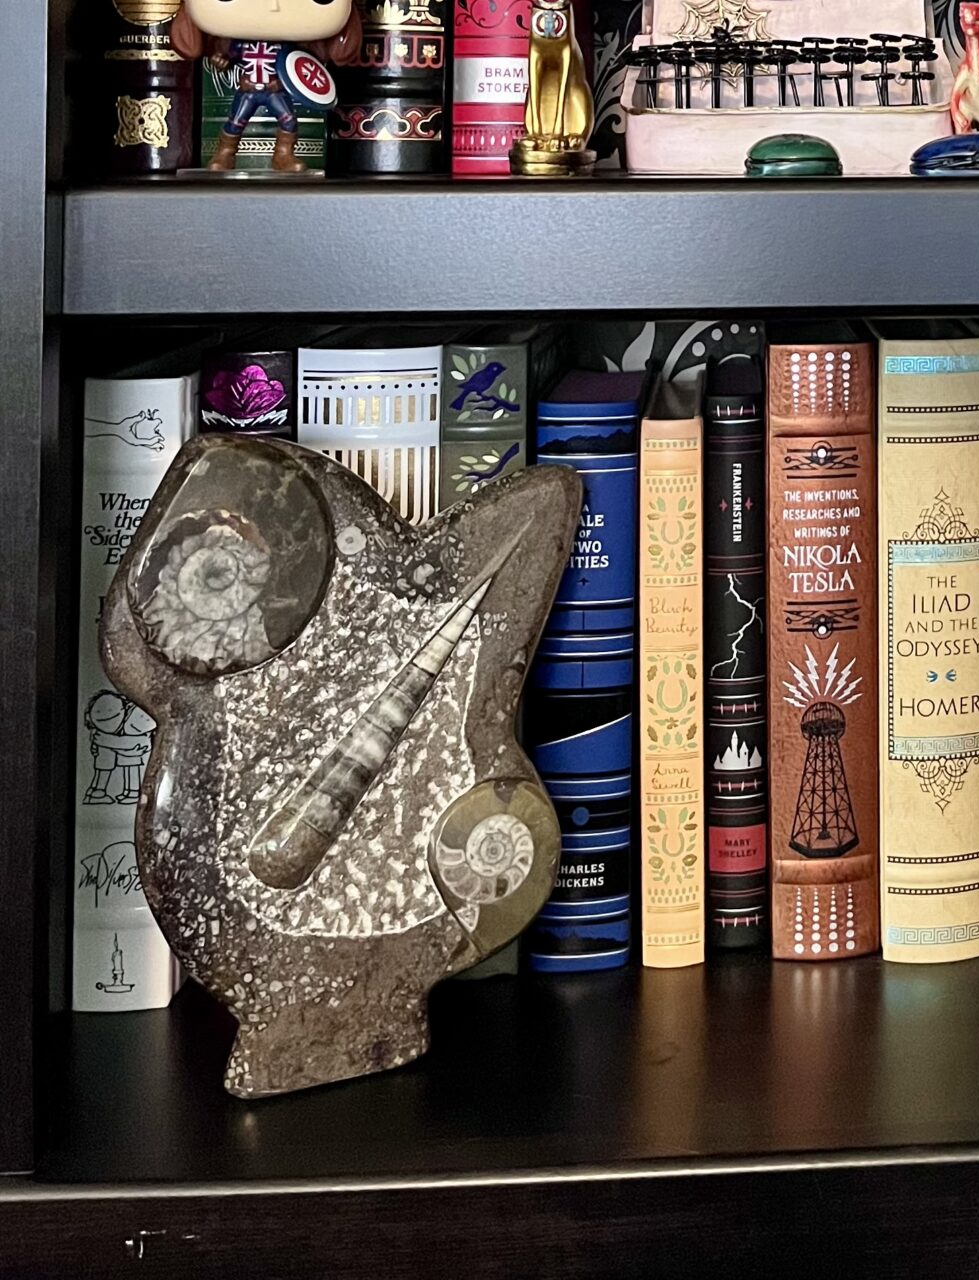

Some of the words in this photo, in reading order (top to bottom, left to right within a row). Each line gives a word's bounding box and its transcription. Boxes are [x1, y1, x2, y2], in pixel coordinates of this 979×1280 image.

[120, 34, 170, 45] GUERBER
[484, 66, 525, 79] BRAM
[733, 463, 742, 542] FRANKENSTEIN
[784, 490, 801, 502] THE
[783, 508, 841, 520] RESEARCHES
[843, 507, 860, 517] AND
[579, 530, 591, 538] OF
[794, 527, 837, 538] WRITINGS
[839, 525, 850, 536] OF
[783, 542, 861, 570] NIKOLA
[788, 569, 854, 592] TESLA
[927, 575, 957, 589] THE
[912, 593, 971, 614] ILIAD
[905, 619, 944, 633] AND
[949, 617, 978, 631] THE
